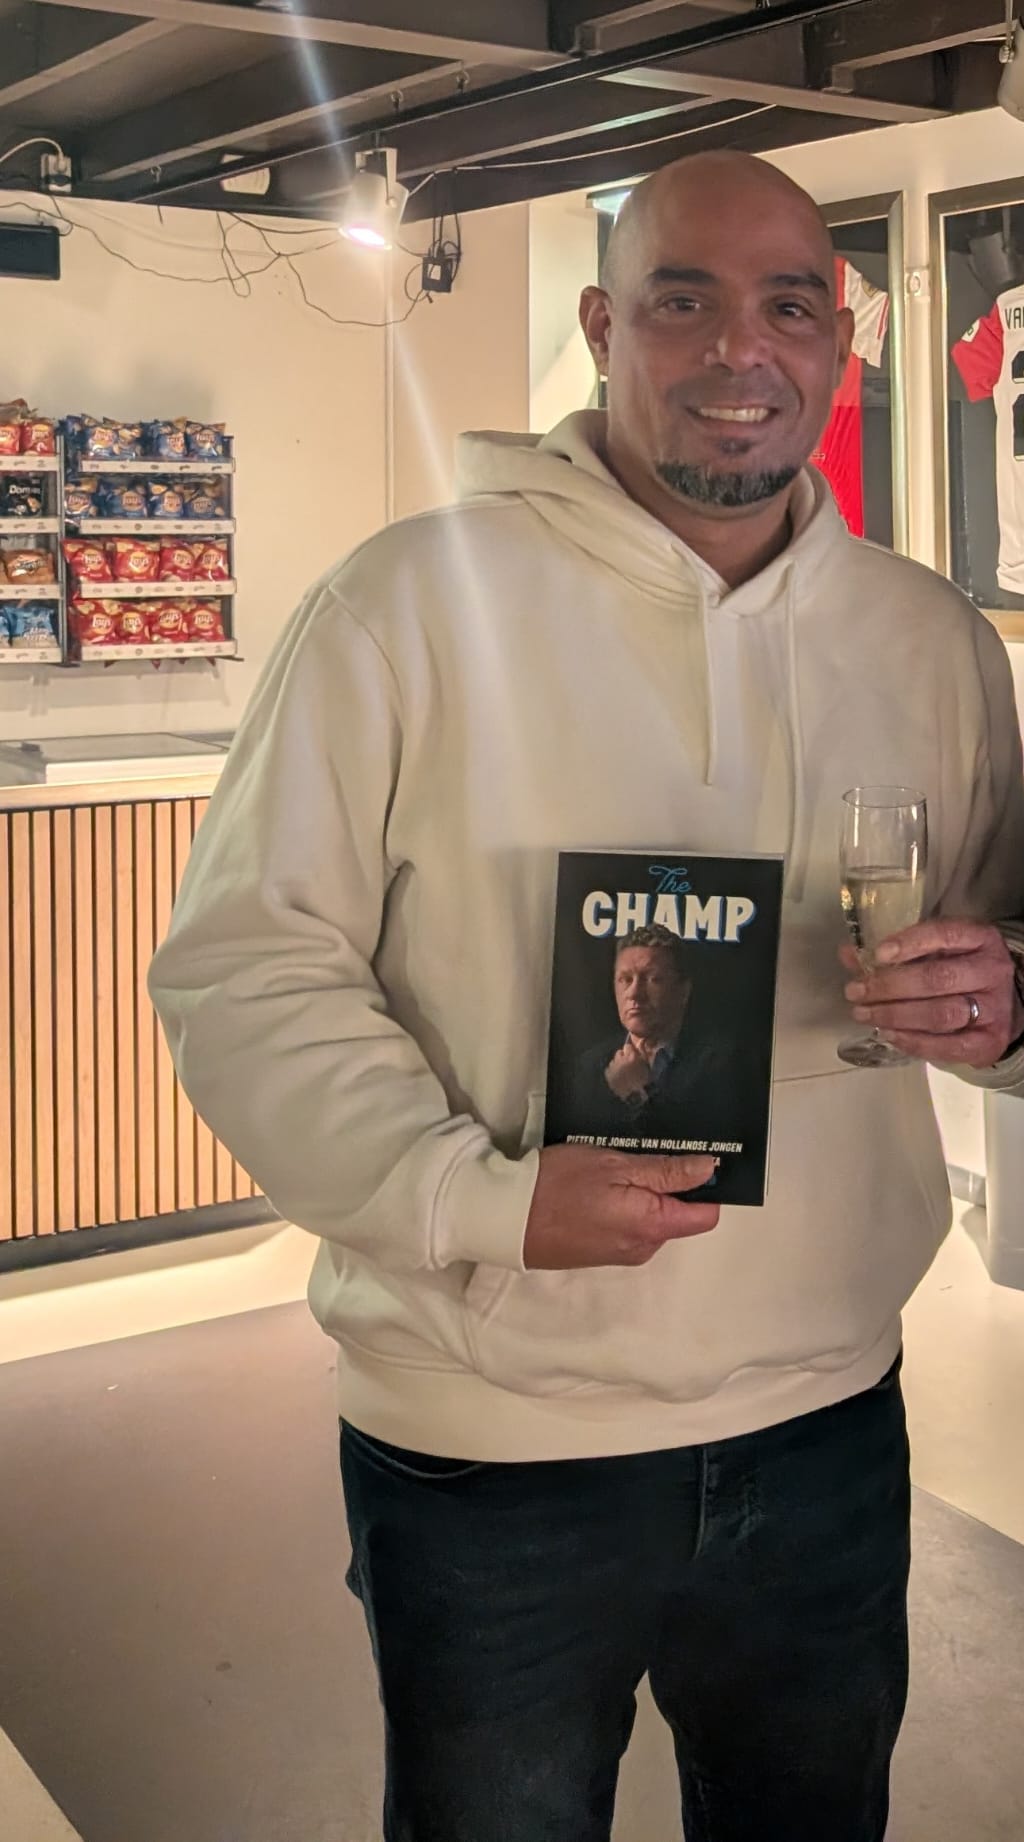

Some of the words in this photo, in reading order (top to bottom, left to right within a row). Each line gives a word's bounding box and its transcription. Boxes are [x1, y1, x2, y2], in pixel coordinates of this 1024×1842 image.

[649, 865, 692, 893] The
[582, 890, 757, 943] CHAMP
[596, 1136, 607, 1146] DE
[608, 1137, 638, 1148] JONGH:
[642, 1138, 657, 1149] VAN
[660, 1139, 707, 1151] HOLLANDSE
[709, 1141, 742, 1153] JONGEN
